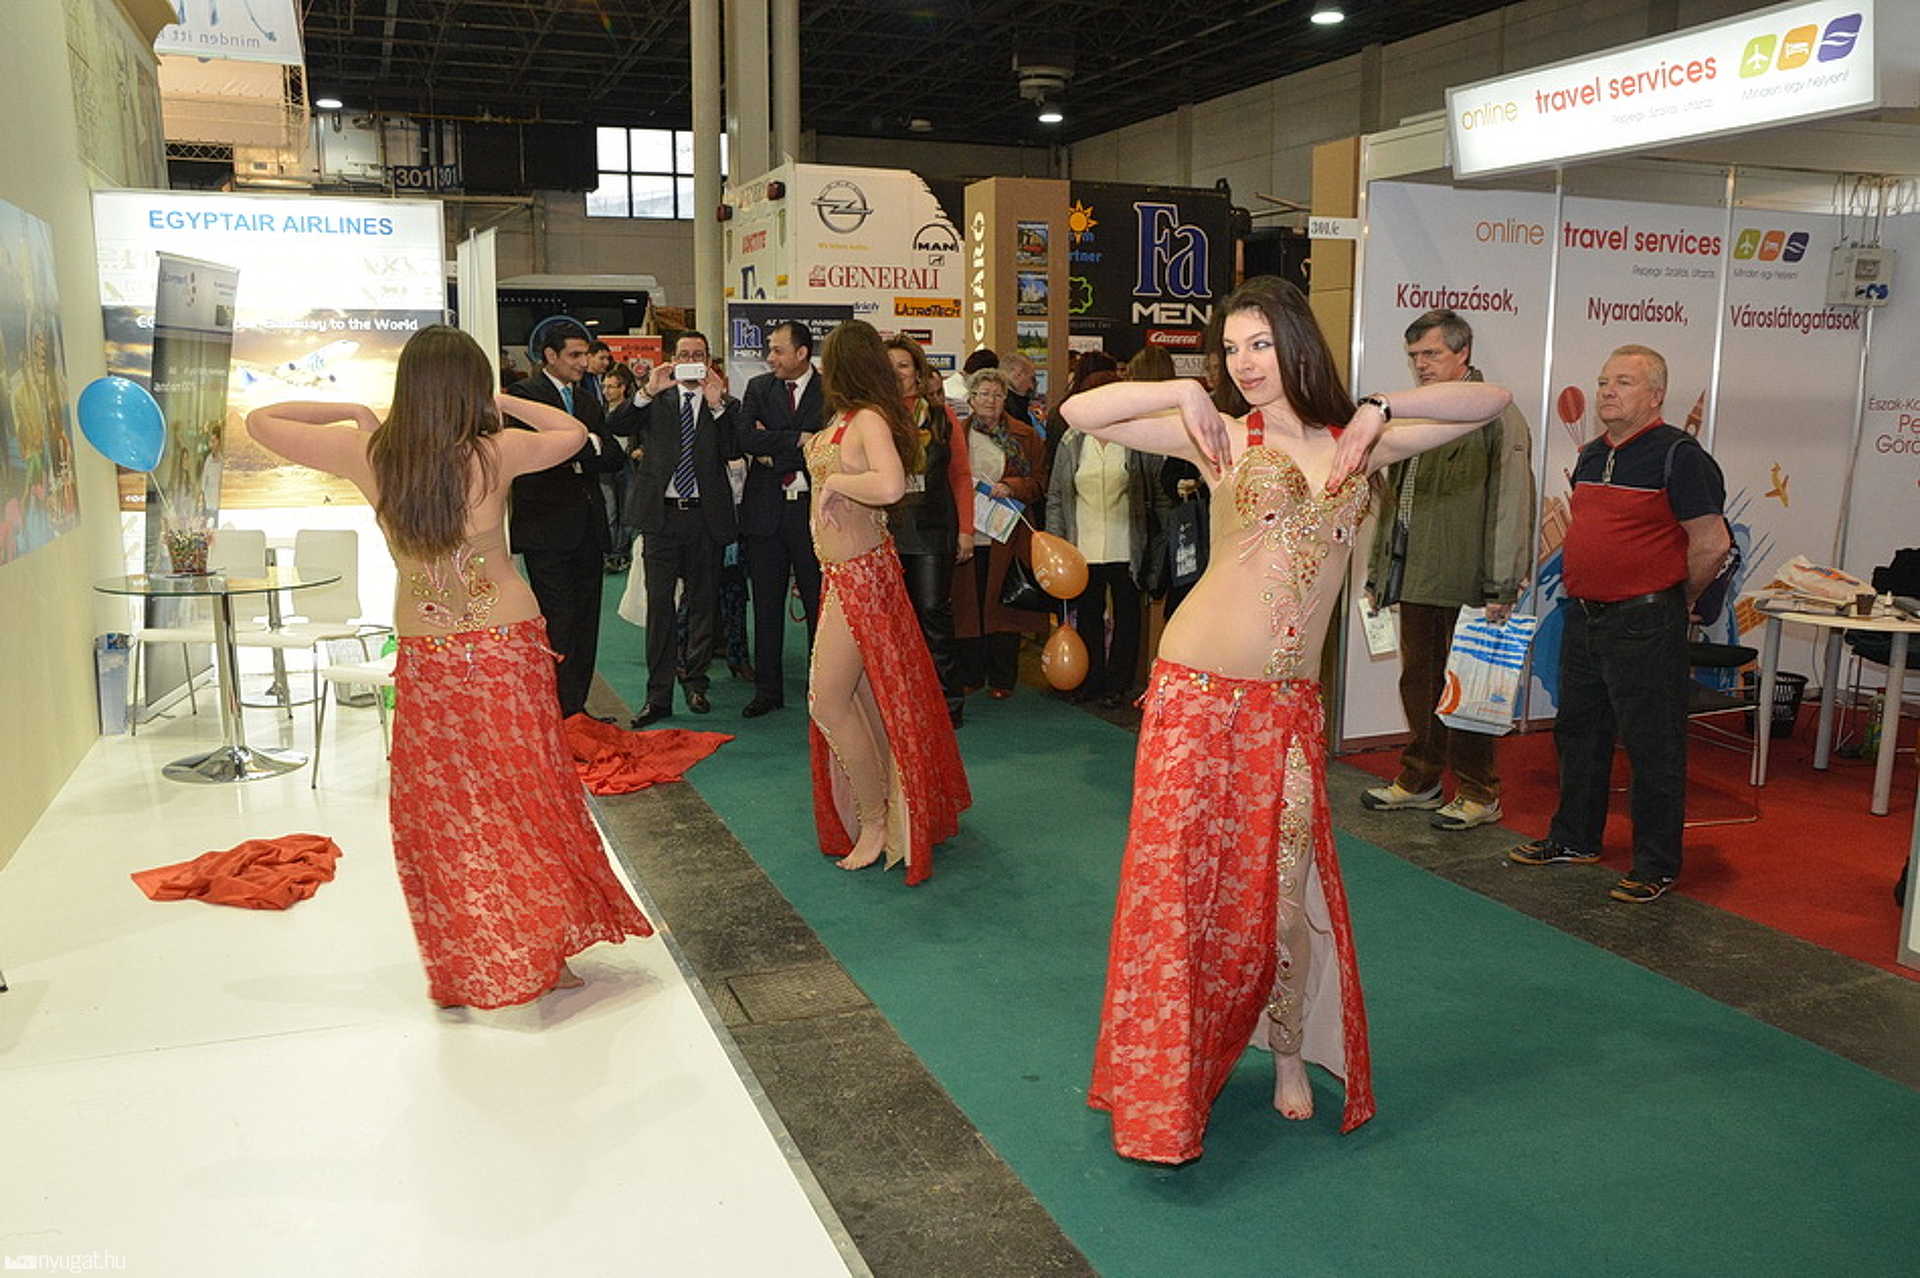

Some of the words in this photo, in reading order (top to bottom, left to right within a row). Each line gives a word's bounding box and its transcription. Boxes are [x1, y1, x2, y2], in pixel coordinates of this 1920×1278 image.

[1461, 99, 1519, 131] online
[1535, 76, 1601, 114] travel
[1608, 55, 1718, 100] services
[396, 168, 432, 187] 301
[148, 210, 275, 232] EGYPTAIR
[282, 215, 394, 236] AIRLINES
[1475, 218, 1545, 246] online
[917, 241, 957, 252] MAN
[1132, 201, 1213, 298] Fa
[1564, 222, 1629, 251] travel
[1634, 228, 1722, 256] services
[828, 265, 940, 290] GENERALI
[1395, 282, 1519, 316] Körutazások,
[1587, 297, 1689, 327] Nyaralások,
[331, 319, 346, 330] to
[349, 319, 372, 331] the
[374, 319, 418, 331] World
[1131, 301, 1213, 326] MEN
[1149, 331, 1201, 345] Carrera
